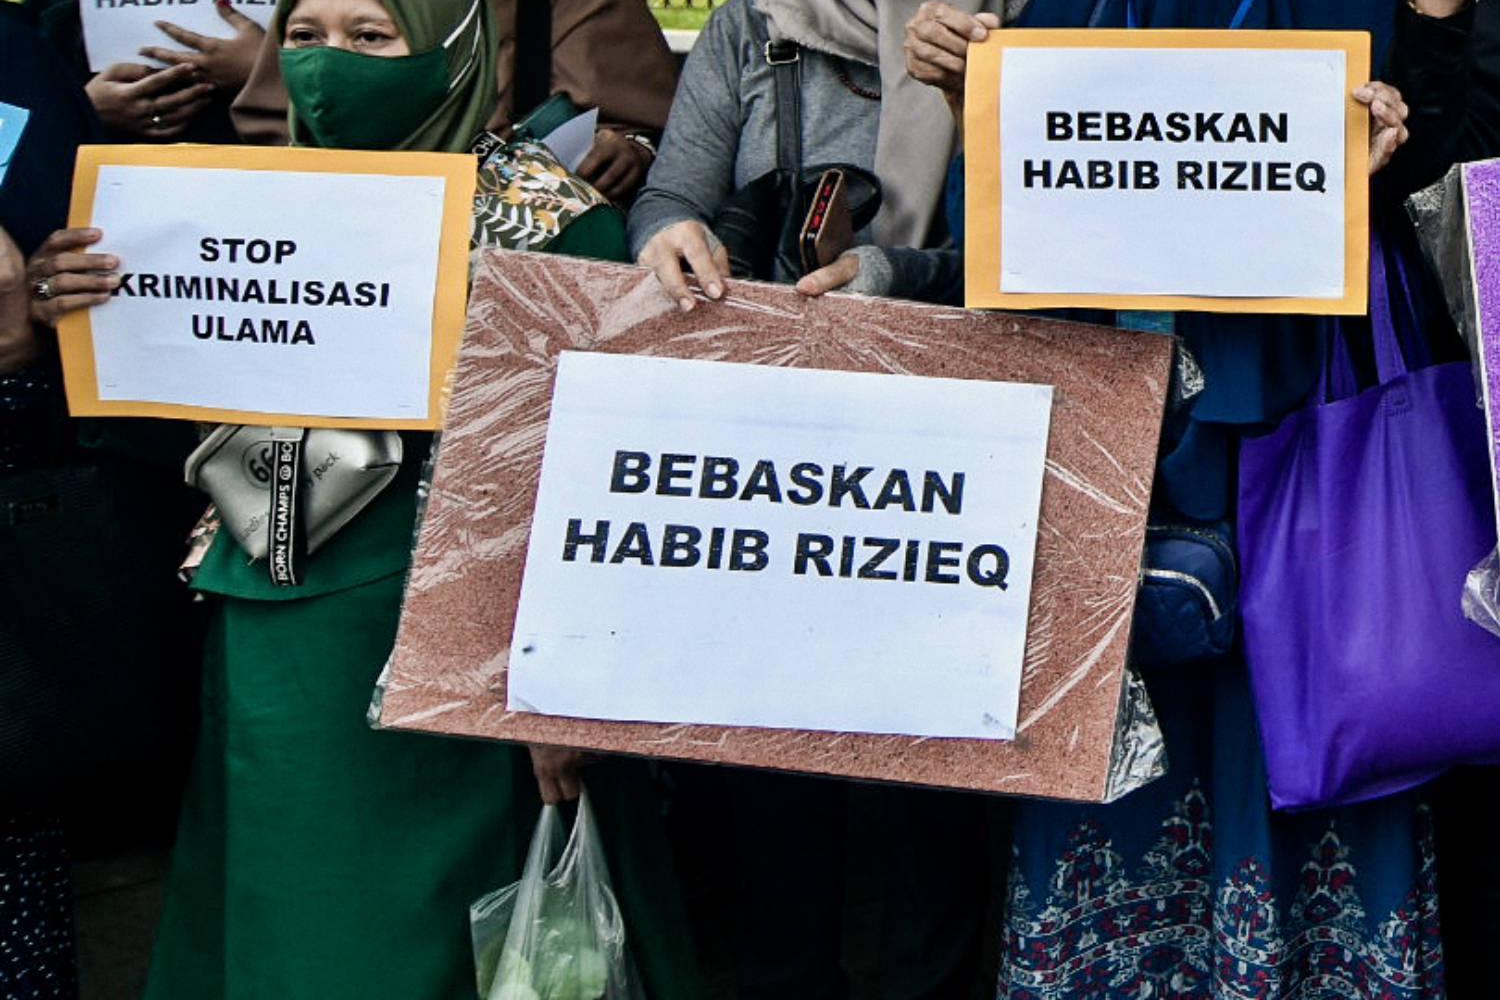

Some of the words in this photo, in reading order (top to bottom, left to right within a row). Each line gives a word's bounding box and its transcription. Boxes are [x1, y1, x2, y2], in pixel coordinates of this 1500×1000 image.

[1046, 111, 1288, 143] BEBASKAN
[1023, 160, 1160, 190] HABIB
[1177, 160, 1326, 194] RIZIEQ
[199, 237, 297, 264] STOP
[112, 273, 390, 307] KRIMINALISASI
[192, 314, 316, 345] ULAMA
[609, 450, 965, 515] BEBASKAN
[276, 484, 291, 541] CHAMPS
[562, 518, 769, 572] HABIB
[793, 533, 1010, 591] RIZIEQ
